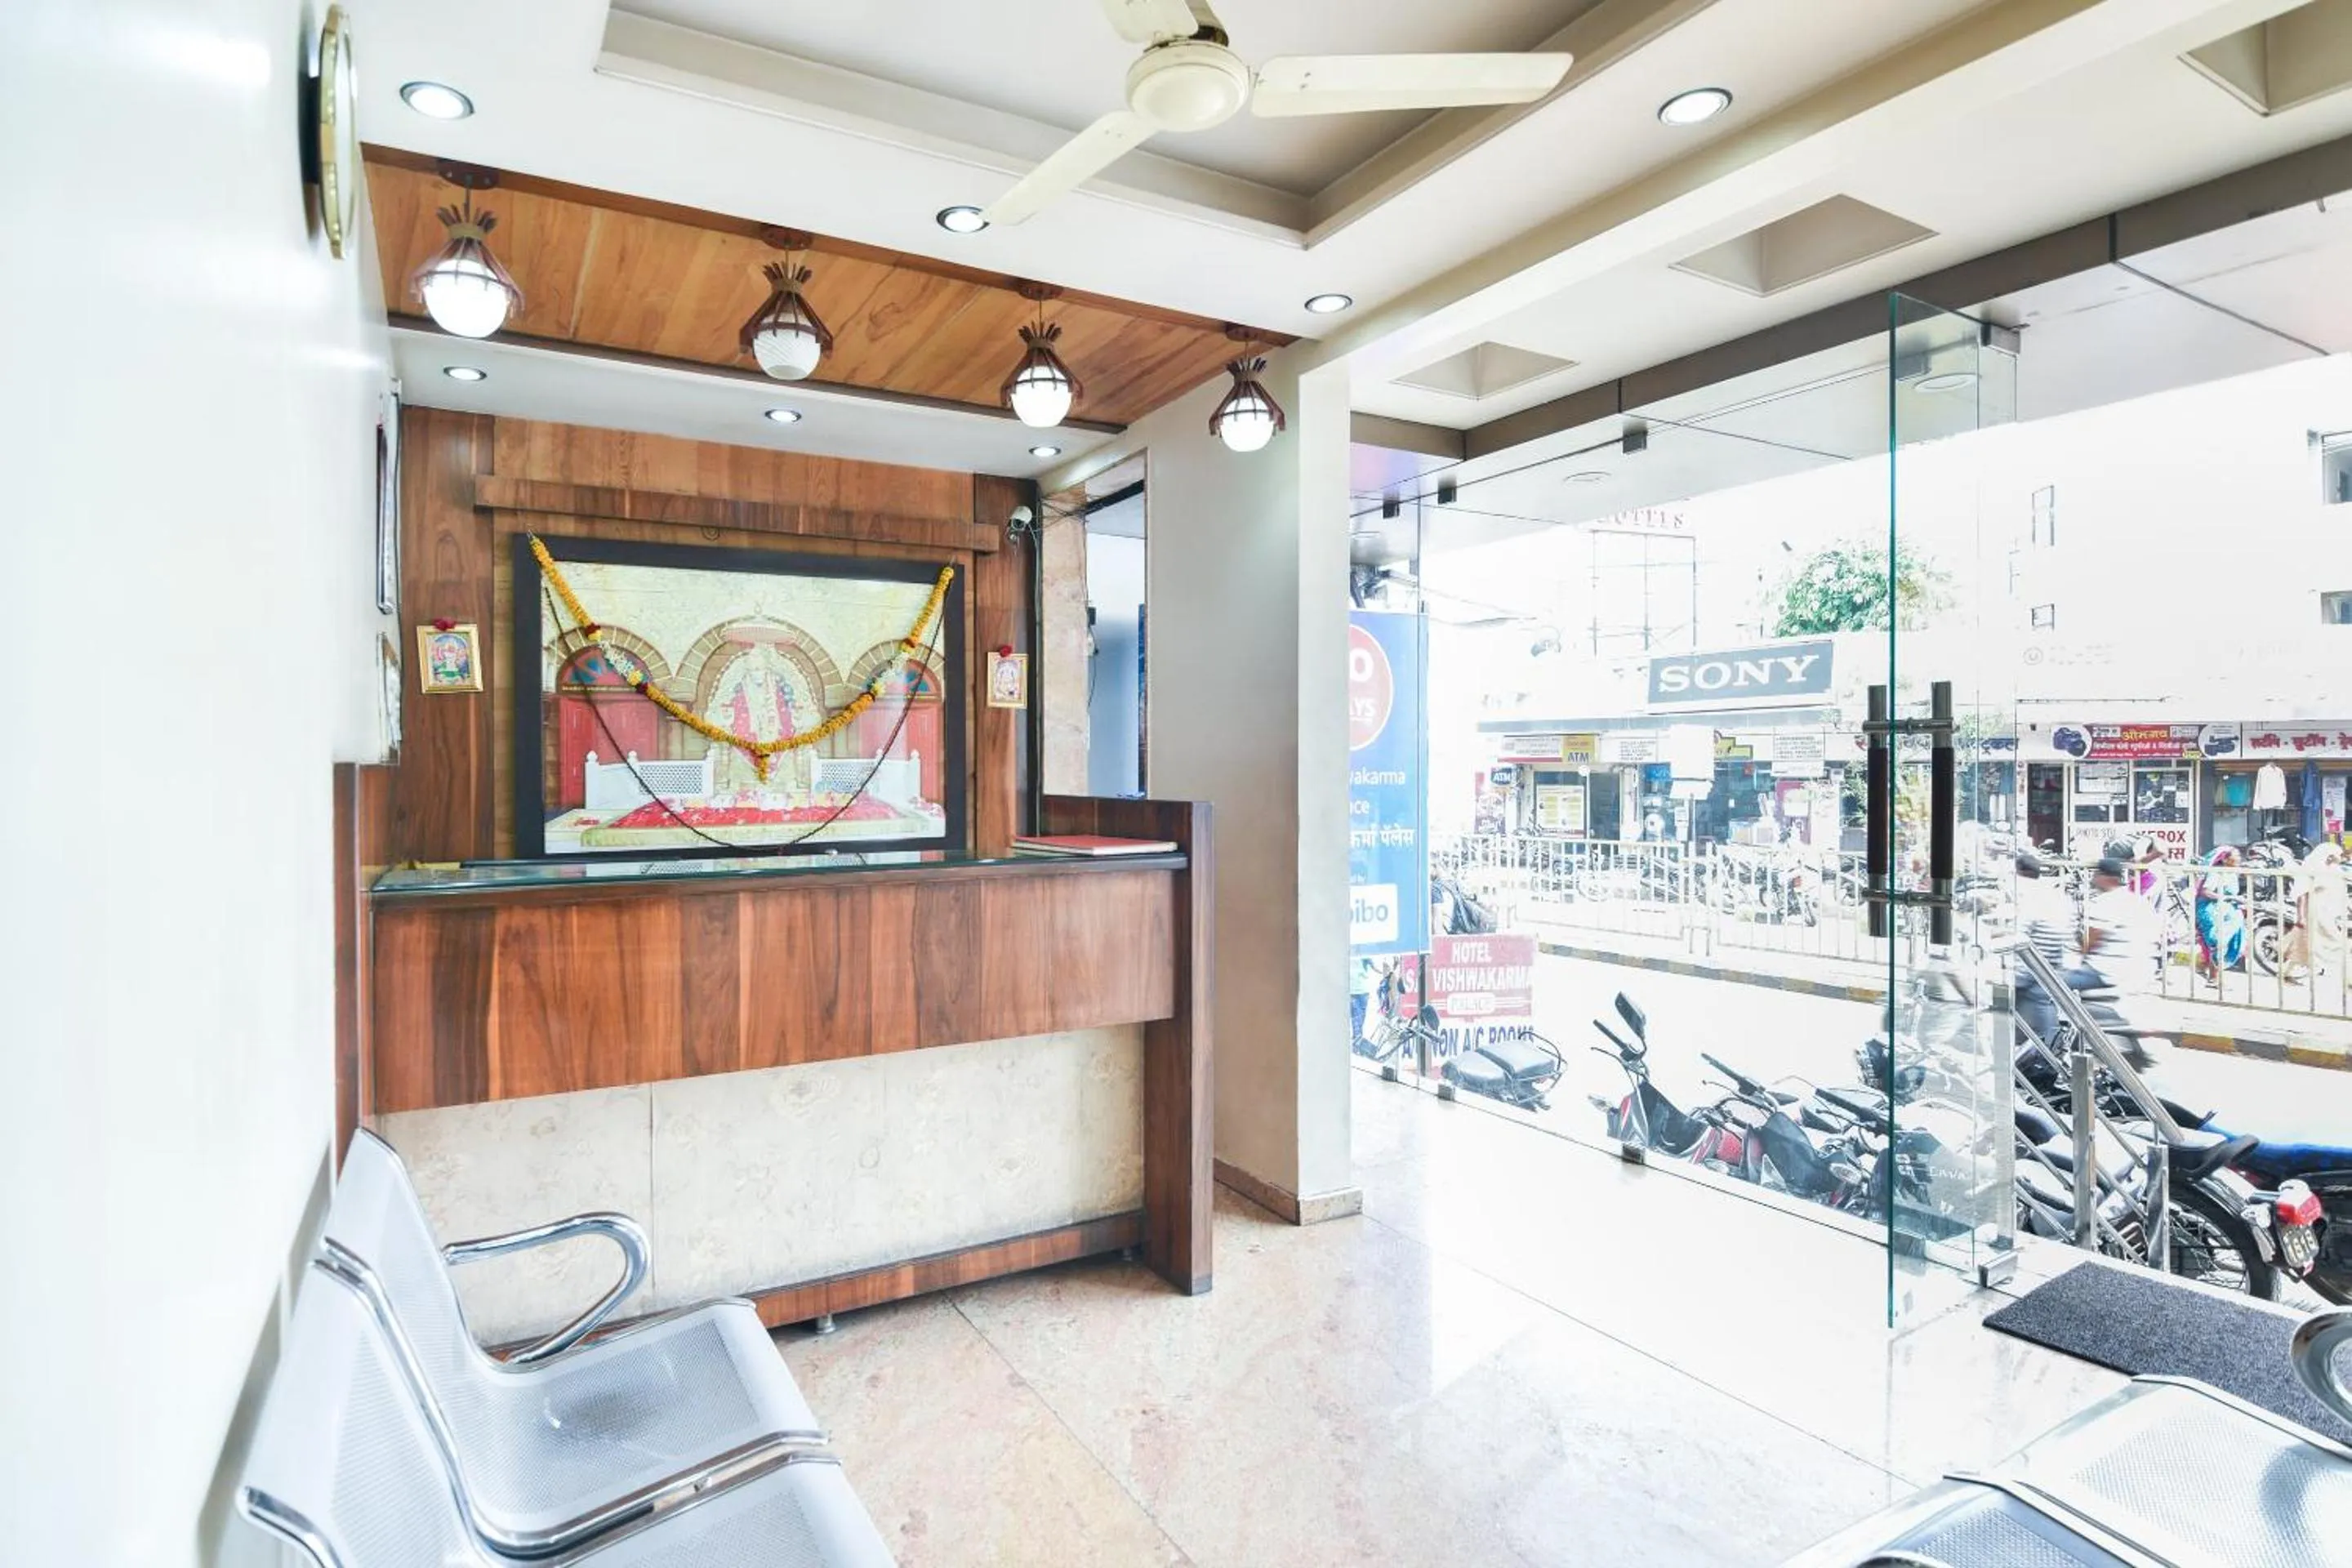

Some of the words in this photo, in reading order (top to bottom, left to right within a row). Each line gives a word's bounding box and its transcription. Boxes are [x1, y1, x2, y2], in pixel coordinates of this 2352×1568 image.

[1658, 655, 1820, 693] SONY
[1567, 751, 1590, 764] ATM
[1349, 767, 1405, 785] akarma
[1493, 772, 1512, 782] ATM
[1350, 899, 1388, 923] ibo
[1452, 942, 1492, 964] HOTEL
